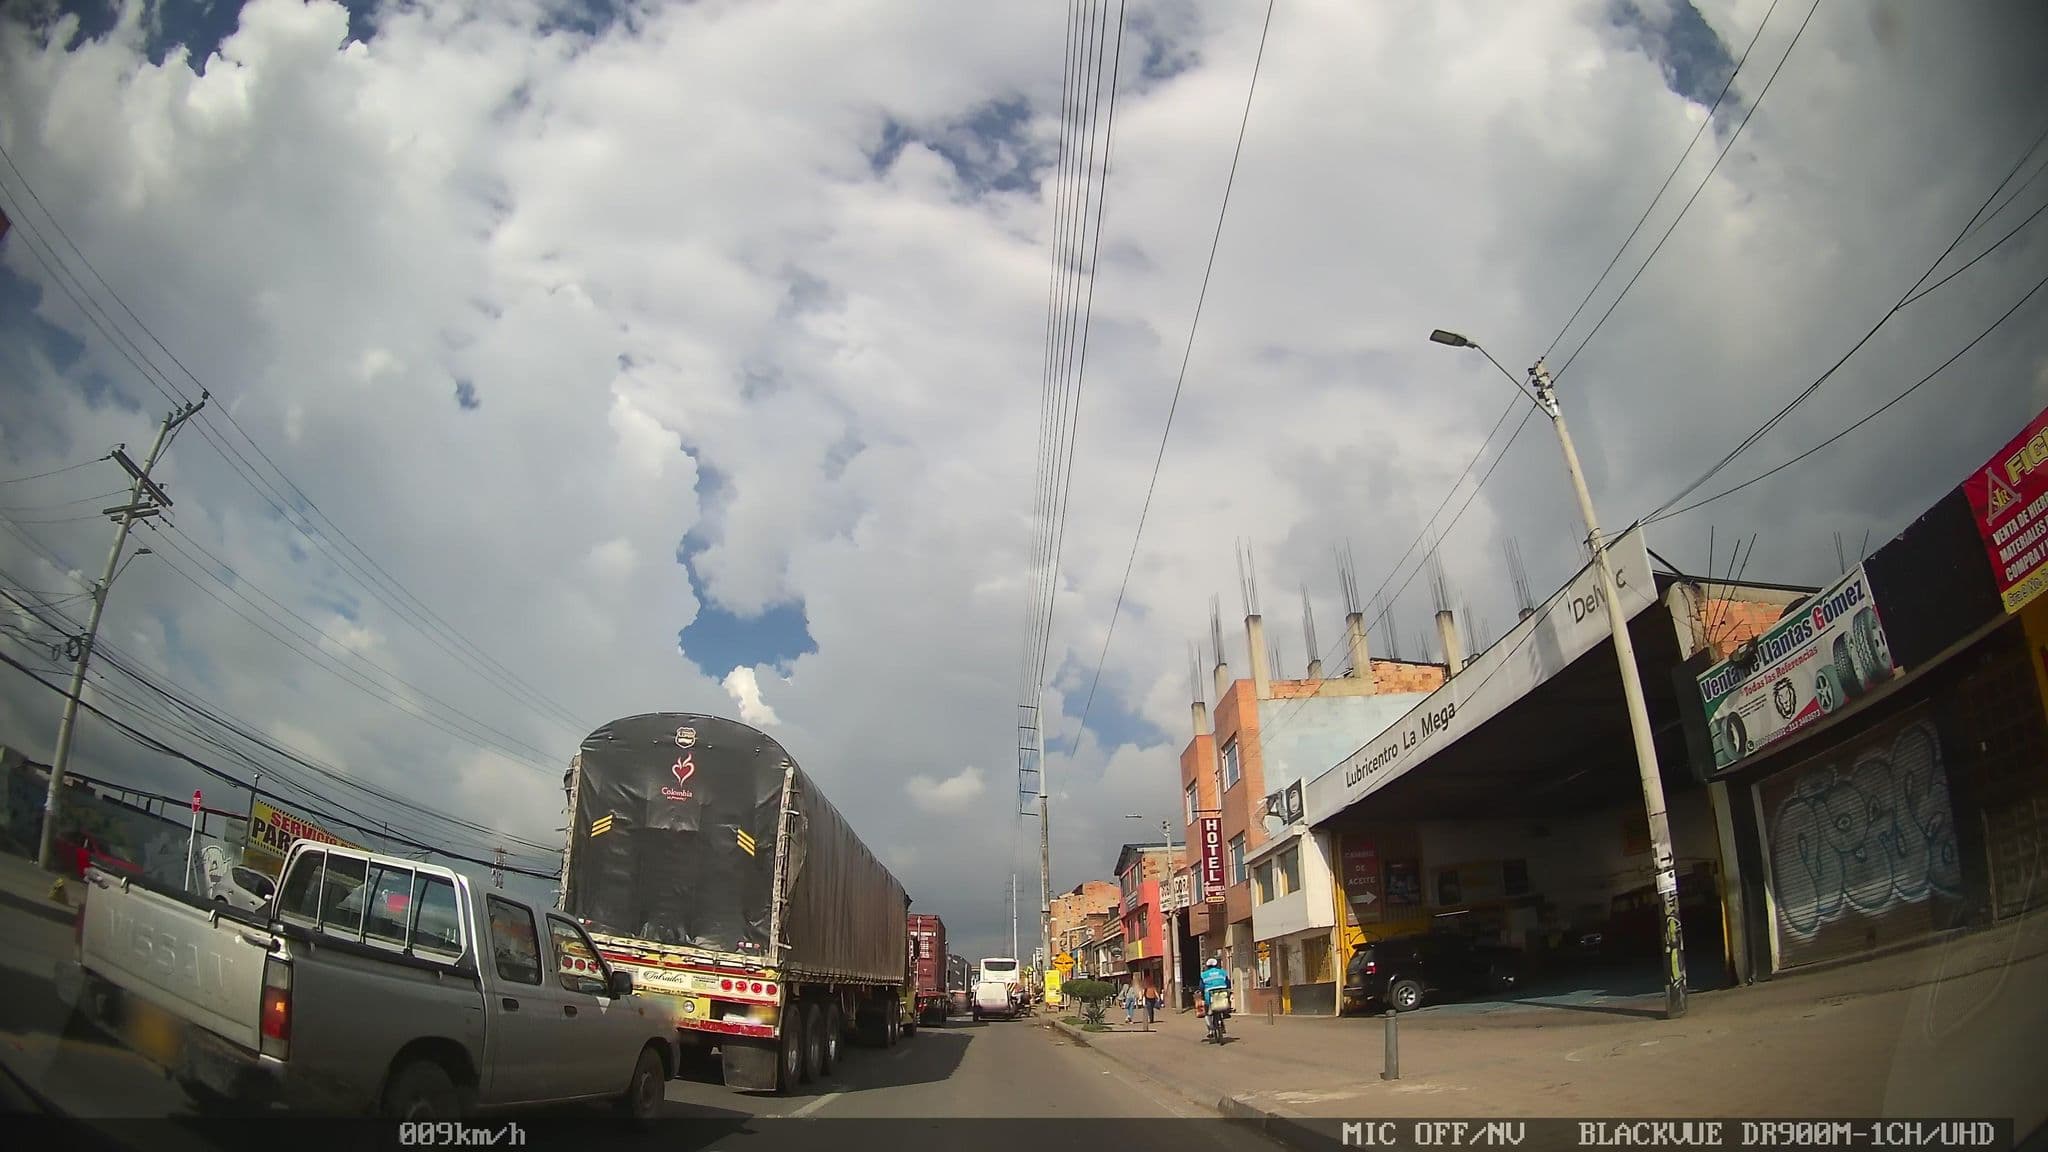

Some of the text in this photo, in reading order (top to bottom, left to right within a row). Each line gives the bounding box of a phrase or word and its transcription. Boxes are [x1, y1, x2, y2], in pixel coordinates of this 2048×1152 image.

[1993, 519, 2020, 546] VENTA
[2017, 510, 2030, 528] DE
[1999, 520, 2046, 564] MATERIALES
[2005, 548, 2041, 582] COMPRA
[1572, 567, 1627, 624] Delvc
[1701, 662, 1741, 701] Venta
[1758, 618, 1813, 667] Llantas
[1811, 579, 1866, 631] Gómez
[1743, 646, 1818, 696] Todas las Referencias
[1345, 701, 1456, 788] Lubricentro La Mega
[661, 787, 693, 798] Colombia
[251, 817, 300, 853] PAR
[1206, 819, 1220, 882] HOTEL
[1347, 876, 1376, 886] ACEITE
